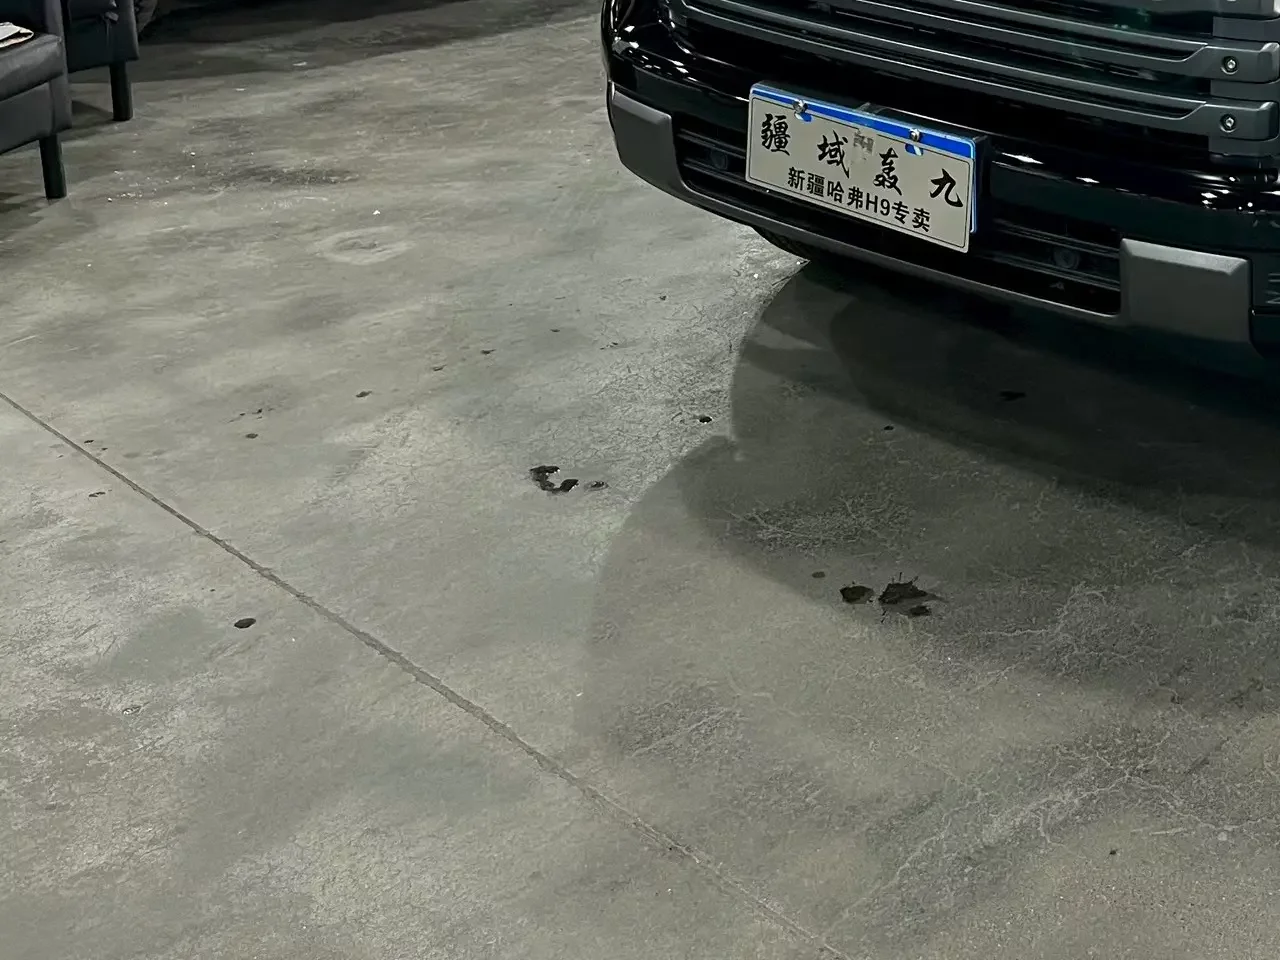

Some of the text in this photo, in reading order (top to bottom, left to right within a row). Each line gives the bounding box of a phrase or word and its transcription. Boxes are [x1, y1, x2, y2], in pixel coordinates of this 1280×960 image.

[787, 166, 931, 233] 新疆哈弗H9专卖
